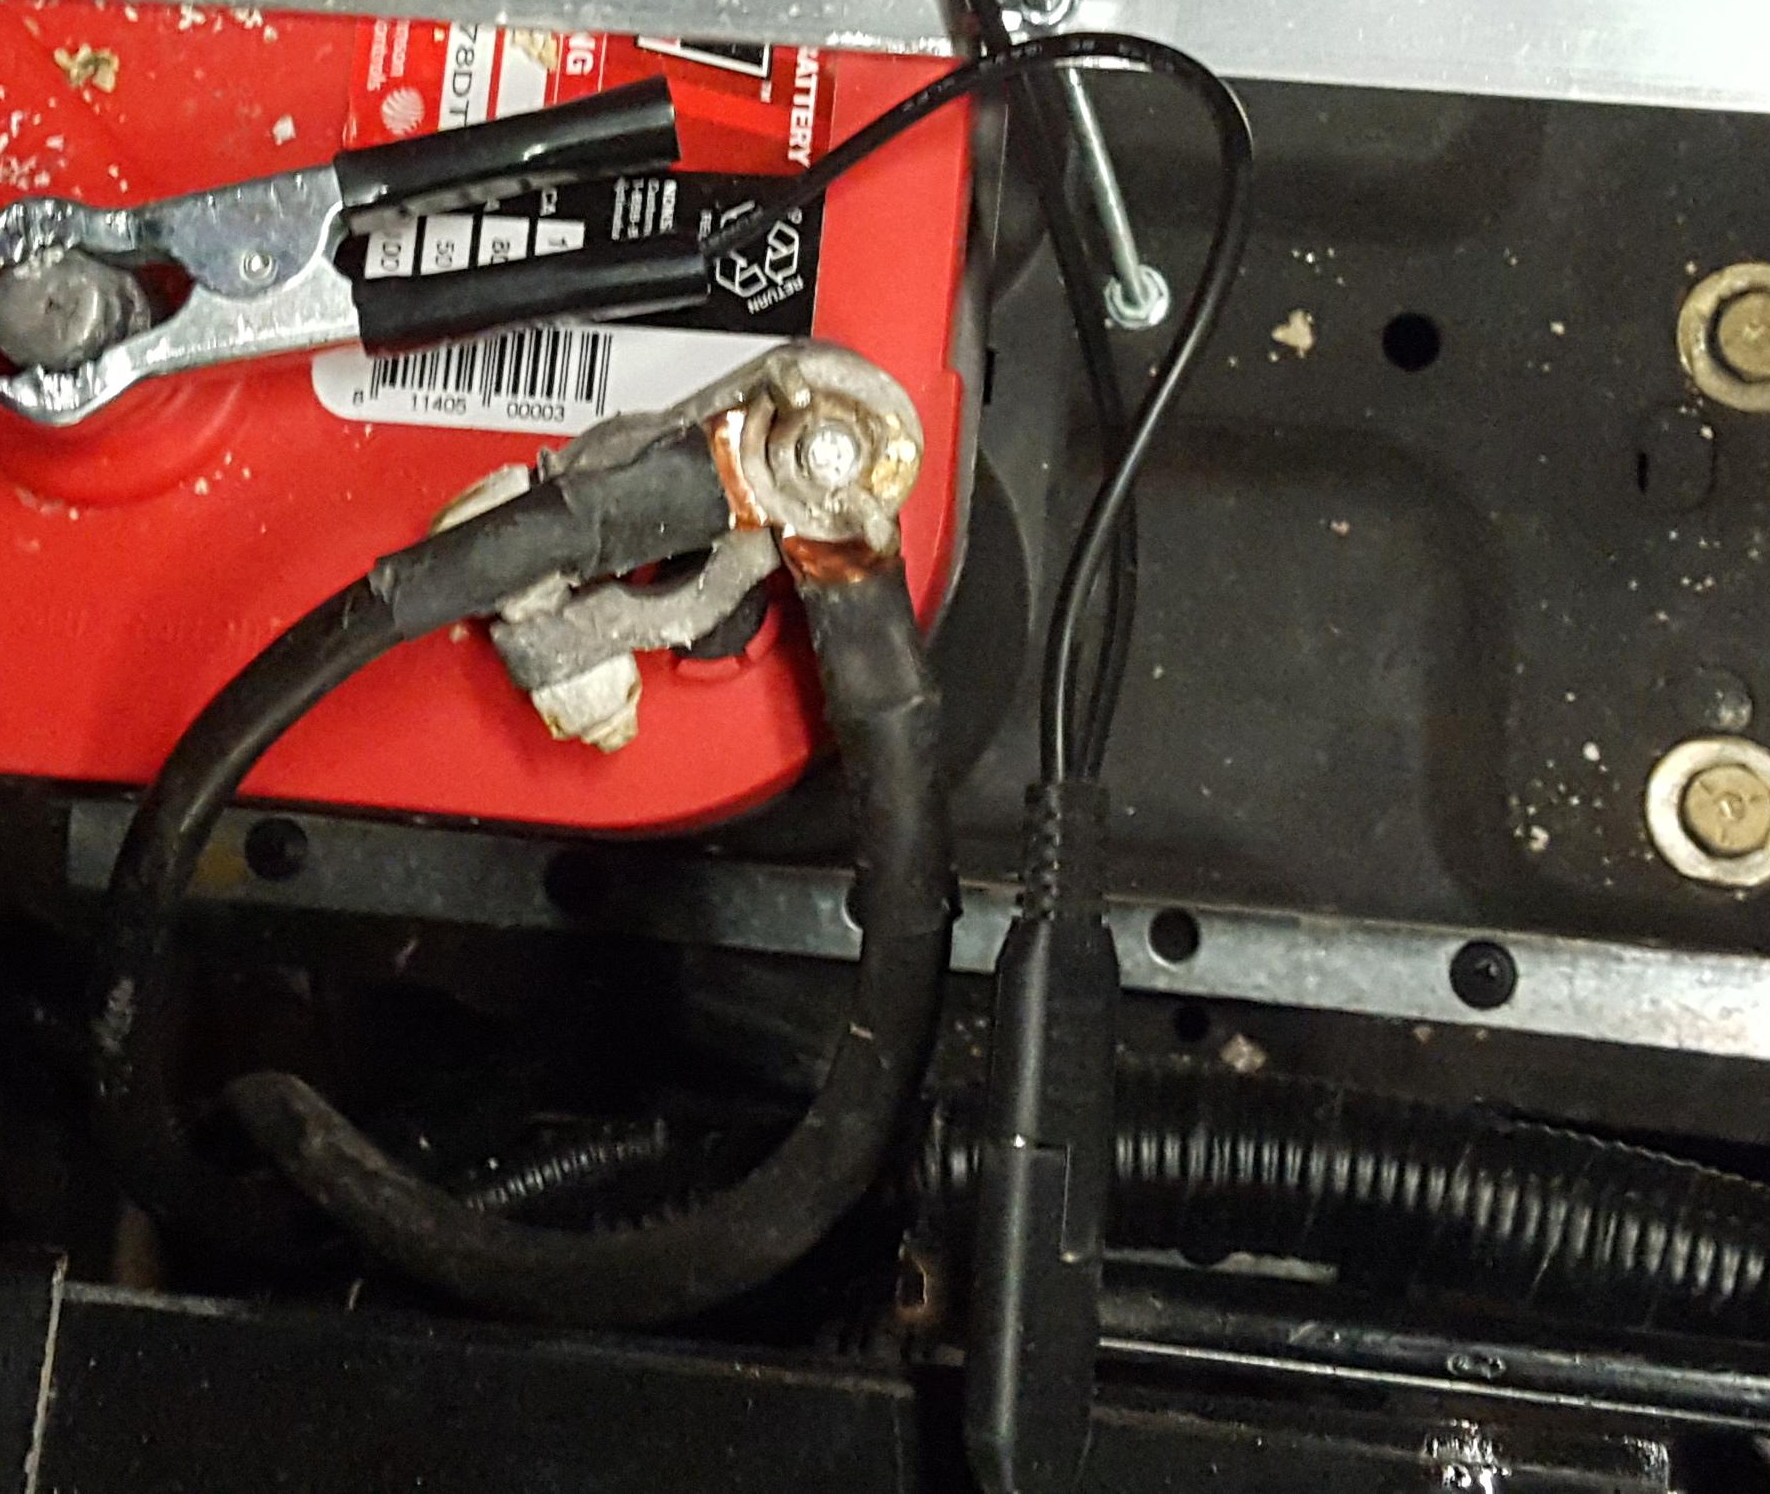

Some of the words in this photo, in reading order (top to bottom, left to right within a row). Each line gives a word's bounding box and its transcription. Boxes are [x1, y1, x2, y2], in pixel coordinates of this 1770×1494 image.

[746, 274, 805, 315] RETURN
[411, 393, 467, 415] 11405
[506, 400, 566, 423] 00003
